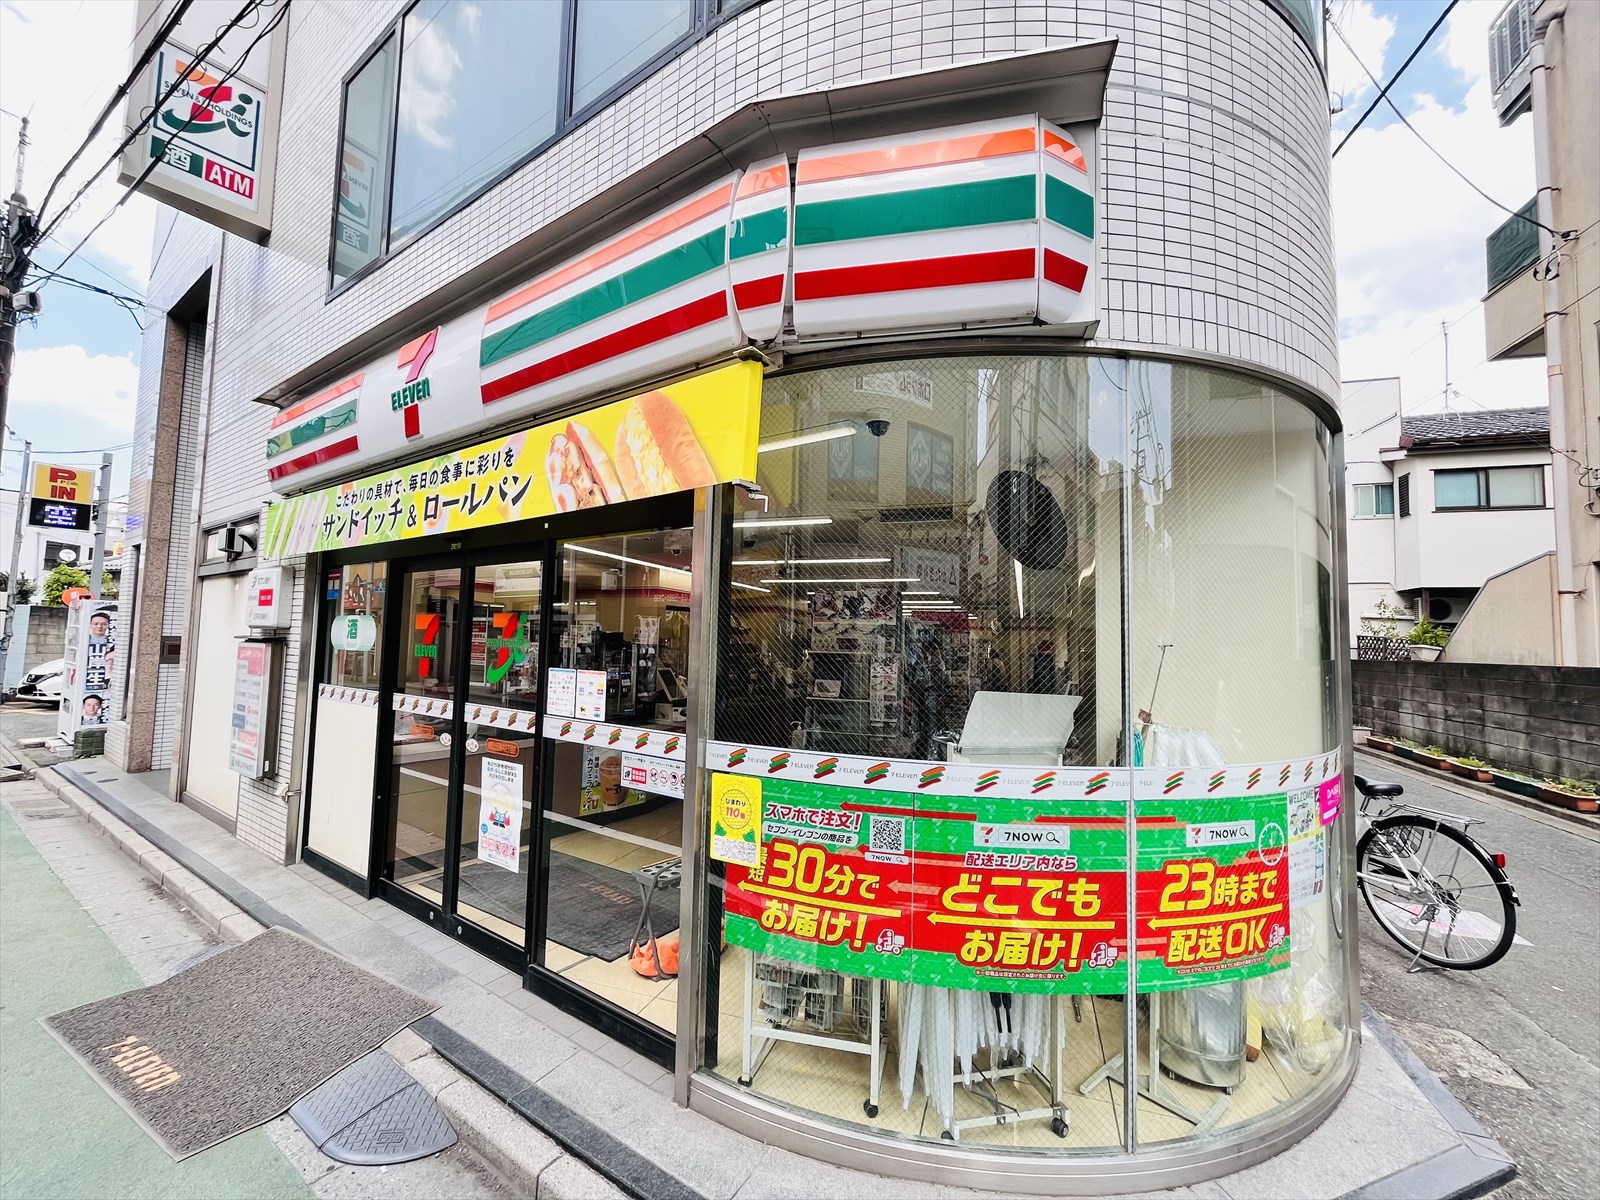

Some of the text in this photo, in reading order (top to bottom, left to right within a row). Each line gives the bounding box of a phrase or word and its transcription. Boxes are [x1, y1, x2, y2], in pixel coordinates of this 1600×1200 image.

[164, 80, 194, 100] SVEN
[208, 101, 253, 129] HOLDINGS
[208, 164, 250, 197] ATM
[49, 467, 77, 482] P
[336, 446, 514, 508] こだわりの具材で、毎日の食事に彩りを
[50, 485, 76, 501] IN
[347, 618, 359, 639] 酒
[725, 798, 746, 807] ひまわり
[1288, 789, 1314, 805] WELCOME
[726, 807, 746, 819] 110
[766, 803, 861, 830] スマホで注文!
[1004, 831, 1043, 843] 7NOW
[1209, 829, 1238, 840] 7NOW
[768, 842, 880, 900] 30分で
[965, 853, 1077, 870] 配送エリア内なら
[941, 873, 1102, 917] どこでも
[1159, 861, 1279, 913] 23時まで
[762, 899, 868, 948] お届け!
[960, 930, 1083, 968] お届け!
[1167, 917, 1268, 963] 配送OK
